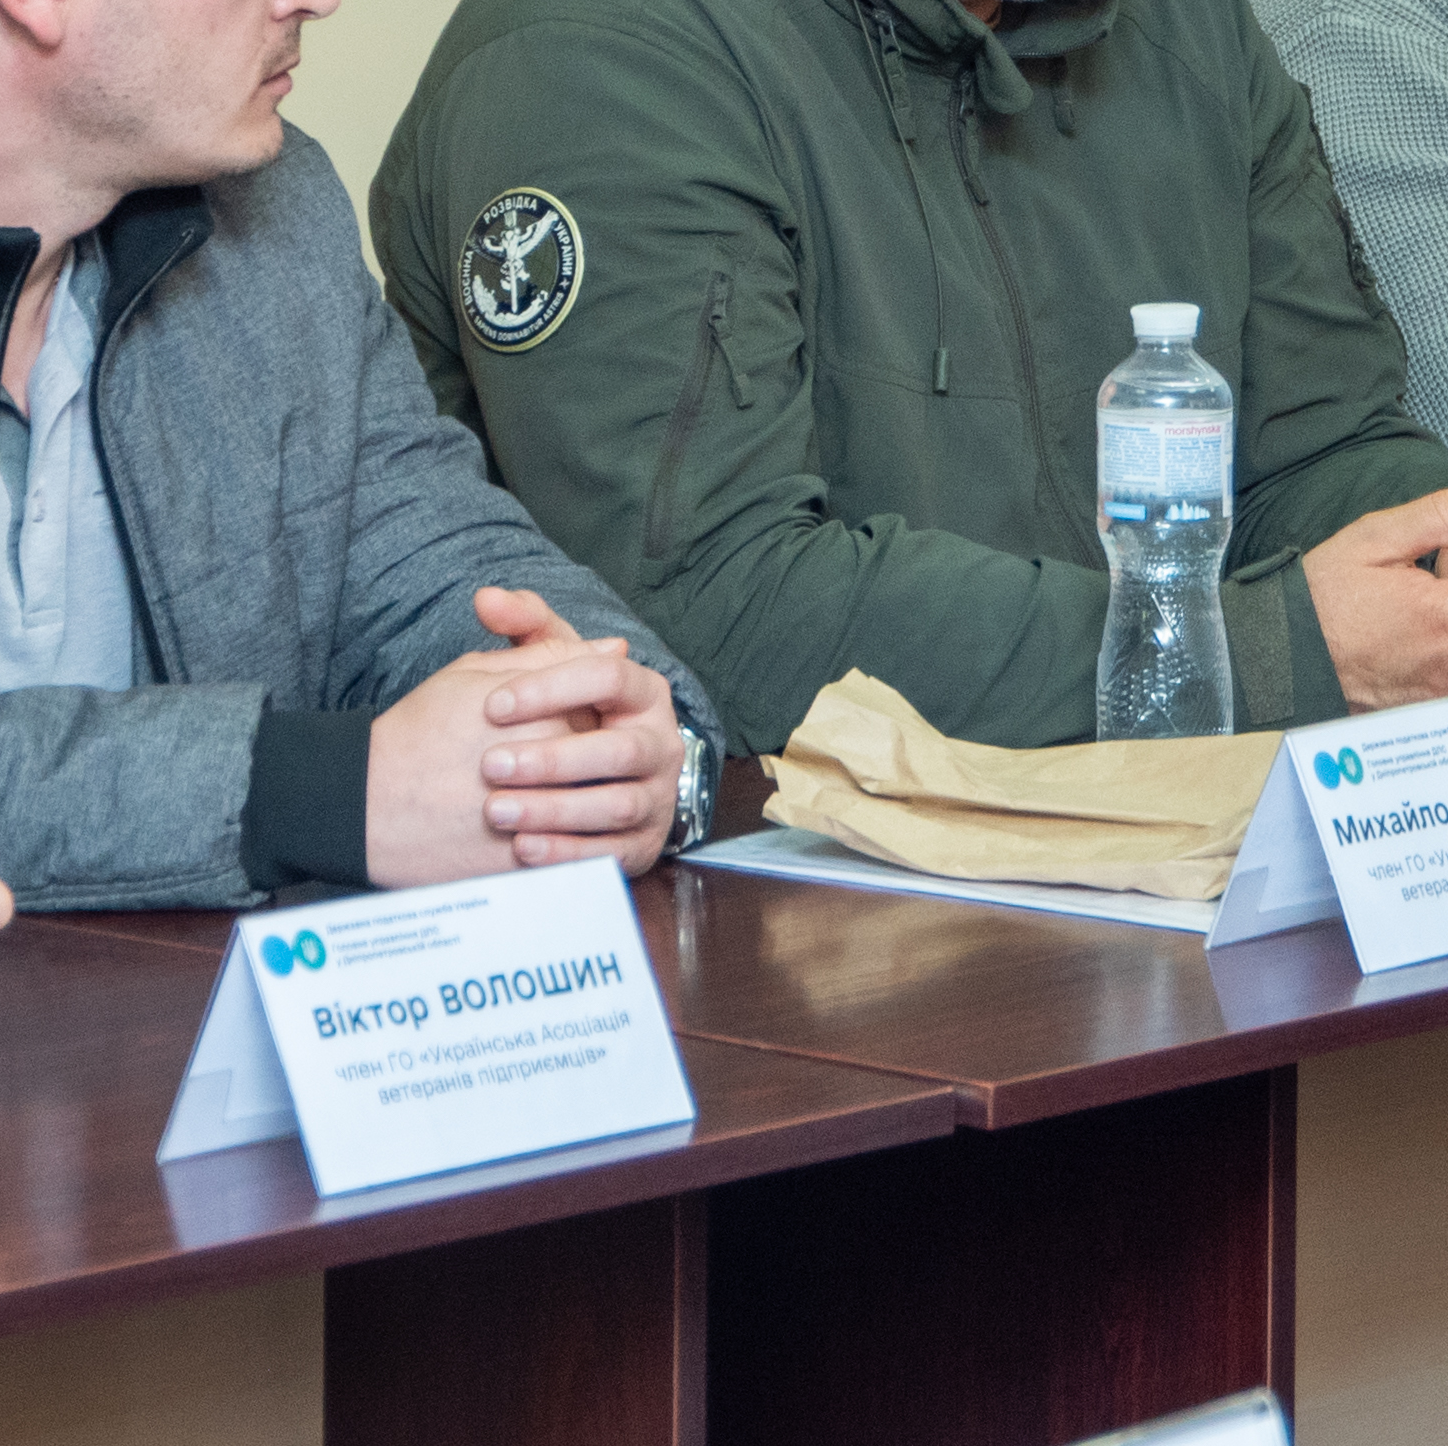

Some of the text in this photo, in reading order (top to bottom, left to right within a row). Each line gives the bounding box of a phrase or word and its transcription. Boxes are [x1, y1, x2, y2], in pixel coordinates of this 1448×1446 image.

[483, 195, 538, 225] РОЗВІДКА
[554, 222, 573, 277] УКРАЇНИ
[1165, 425, 1222, 437] morshynska
[1367, 862, 1405, 881] член
[1404, 853, 1426, 873] ГО
[312, 953, 623, 1039] Віктор ВОЛОШИН
[335, 1009, 631, 1082] член ГО «Українська Асоціація
[378, 1047, 607, 1105] ветеранів підприємців»
